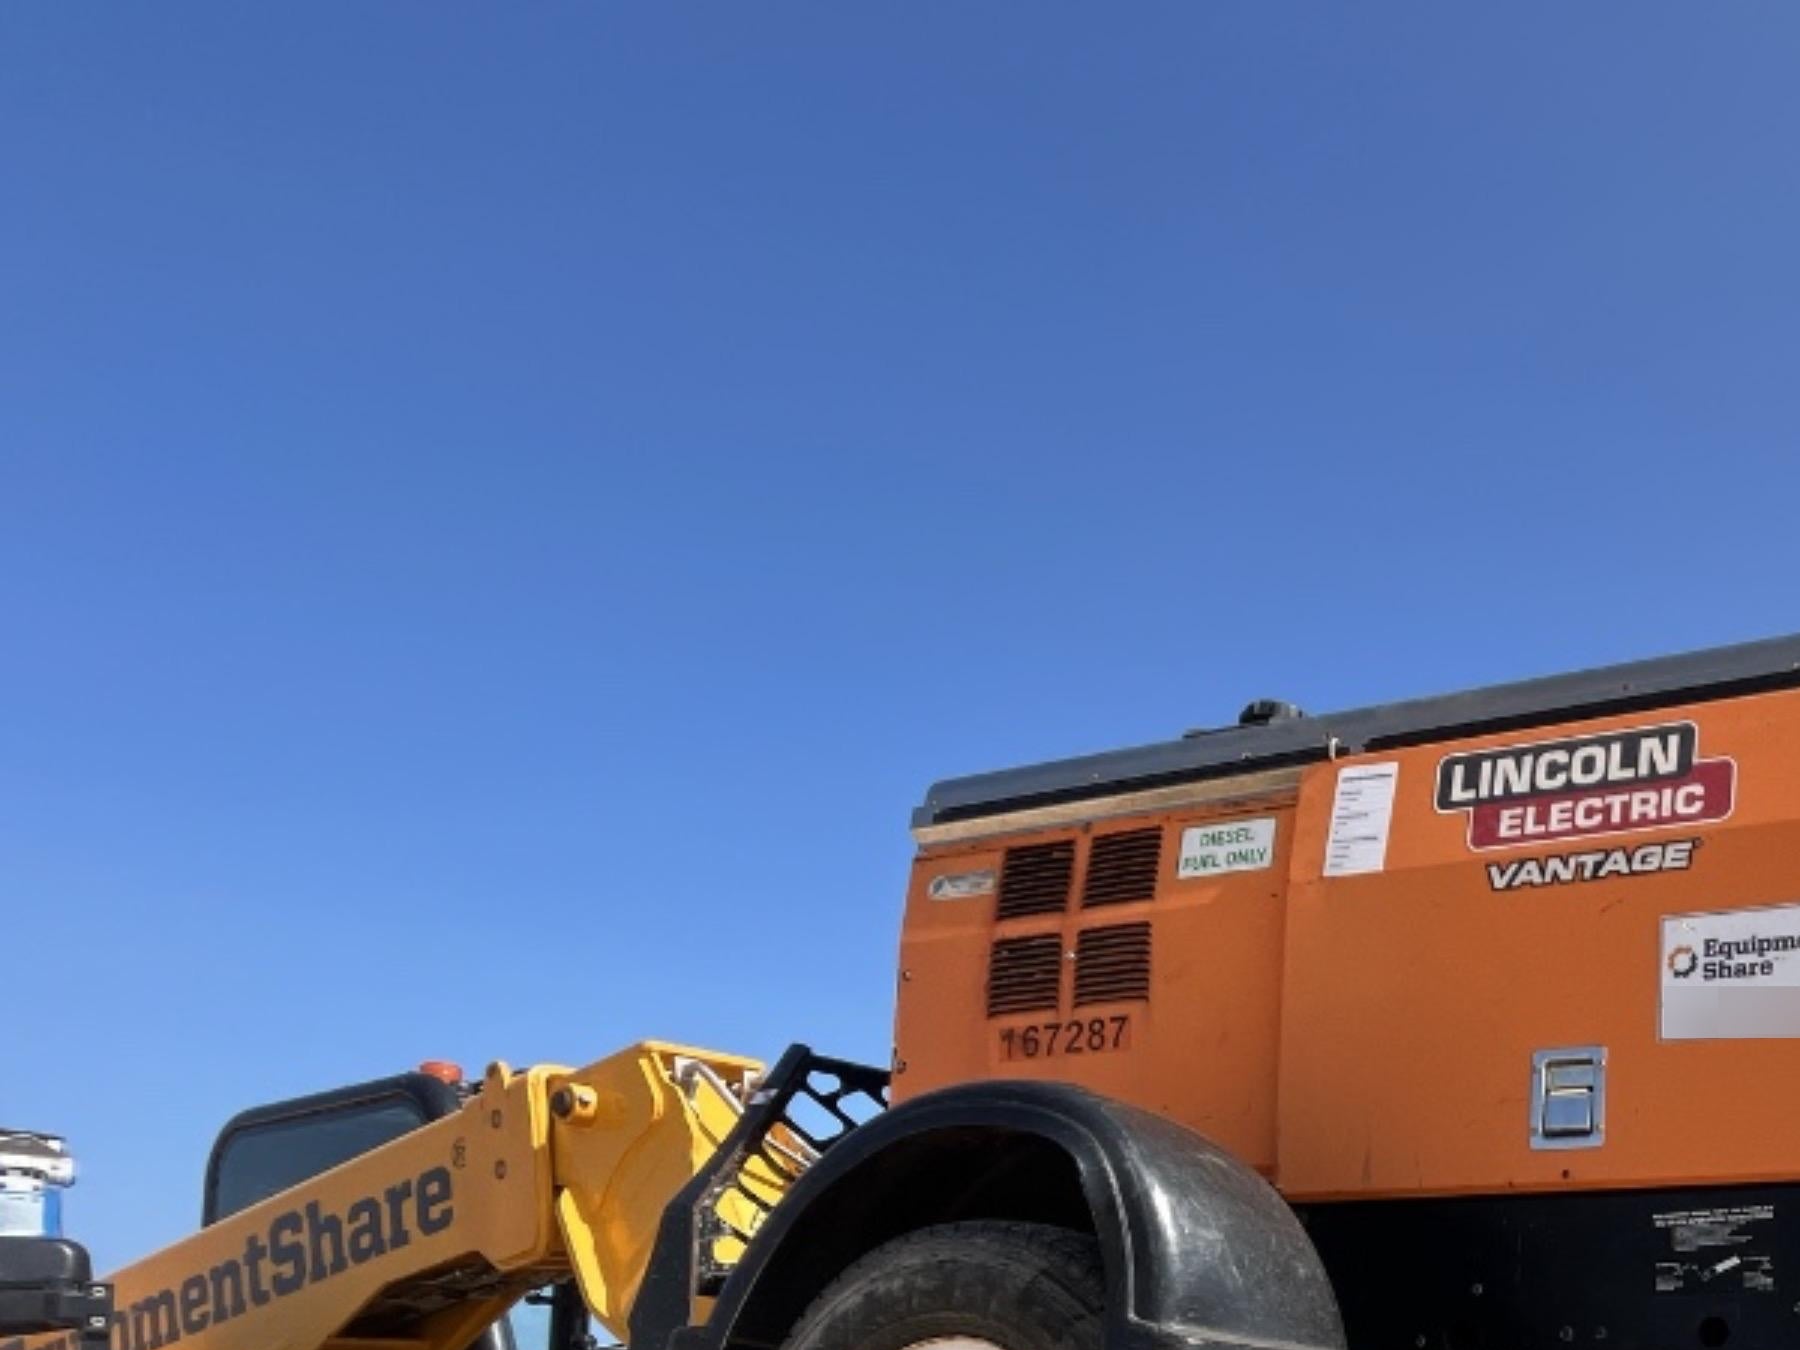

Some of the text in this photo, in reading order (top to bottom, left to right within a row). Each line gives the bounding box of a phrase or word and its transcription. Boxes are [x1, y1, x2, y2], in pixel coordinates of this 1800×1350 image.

[1449, 733, 1682, 802] LINCOLN
[1497, 783, 1706, 839] ELECTRIC
[1199, 826, 1256, 848] DIESEL
[1226, 847, 1267, 867] ONLY
[1486, 840, 1696, 892] VANTAGE
[1702, 960, 1775, 983] Share
[1000, 1015, 1130, 1060] 167287
